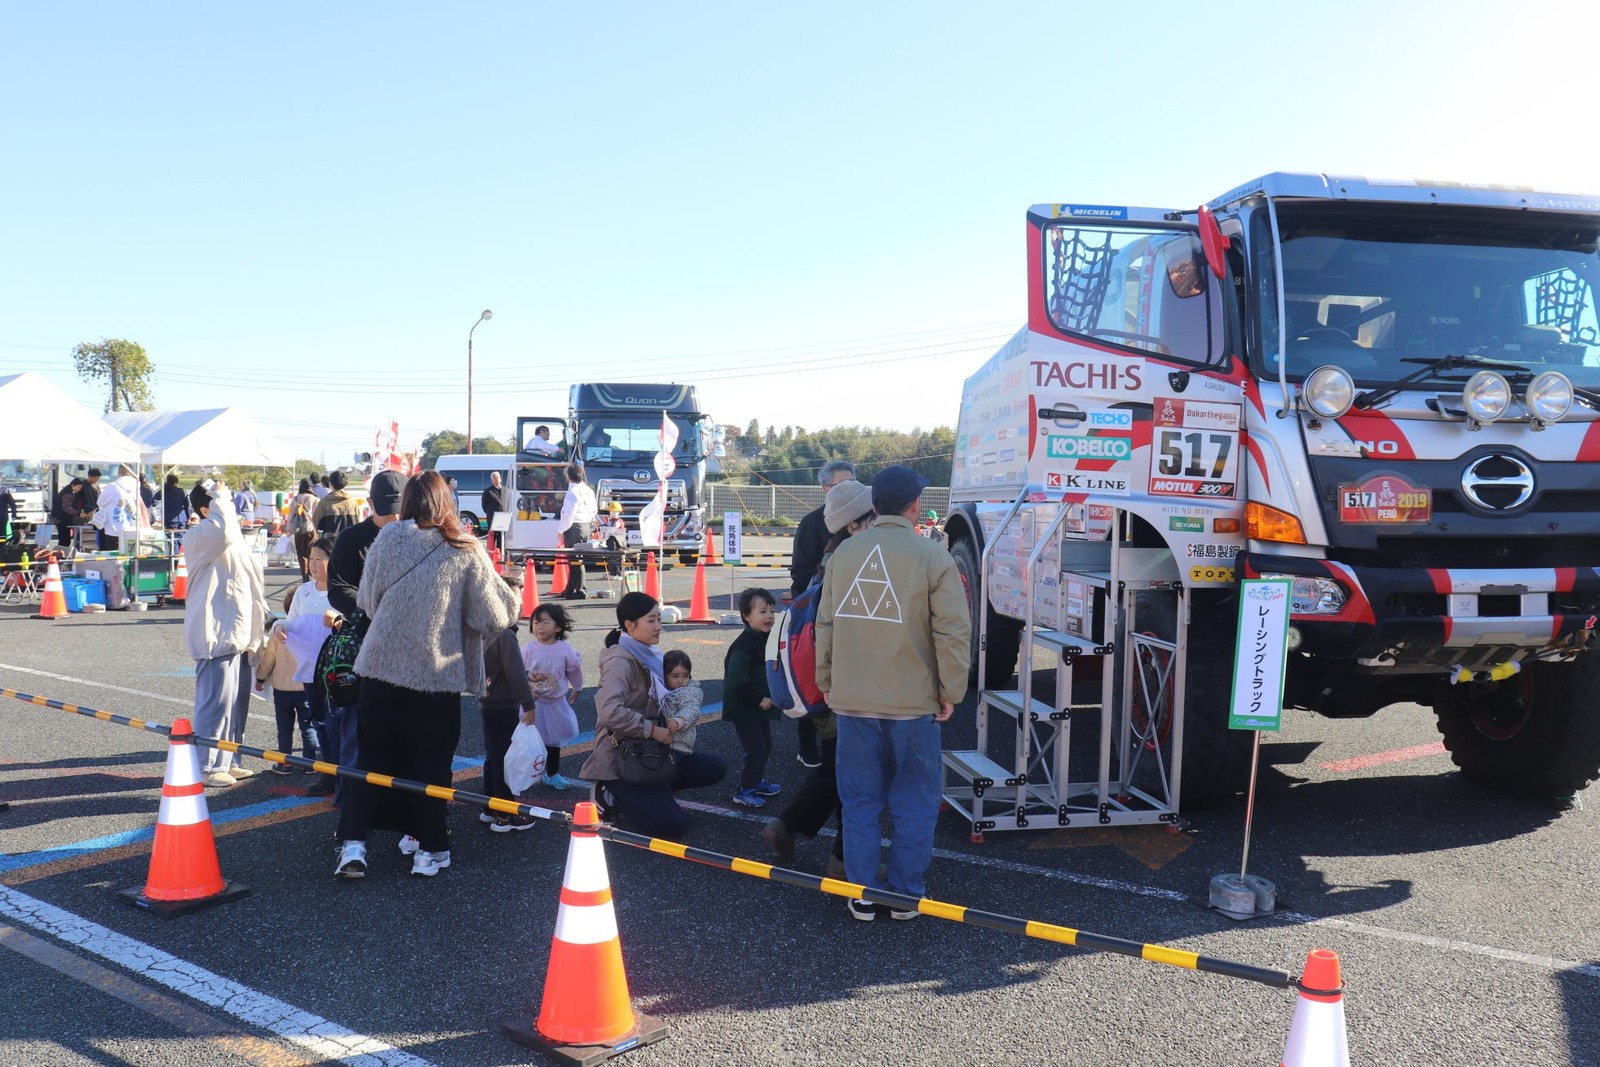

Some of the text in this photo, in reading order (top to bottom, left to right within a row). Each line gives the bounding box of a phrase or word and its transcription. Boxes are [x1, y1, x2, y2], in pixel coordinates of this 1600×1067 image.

[1223, 179, 1263, 202] AUSTRALIA
[1073, 208, 1122, 216] MICHELIN
[1030, 361, 1142, 391] TACHI-S
[625, 396, 657, 404] Quon
[1089, 412, 1130, 426] TECHO
[1186, 409, 1237, 420] Dakarthegame
[1052, 438, 1128, 458] KOBELCO
[1319, 439, 1398, 454] HINO
[1158, 431, 1232, 479] 517
[1087, 479, 1126, 490] LINE
[1153, 481, 1232, 495] MOTUL 300V
[1348, 492, 1373, 507] 517
[1398, 492, 1428, 508] 2019
[870, 562, 878, 570] H
[851, 597, 858, 606] U
[885, 601, 892, 609] F
[1250, 605, 1270, 713] レーシングトラック
